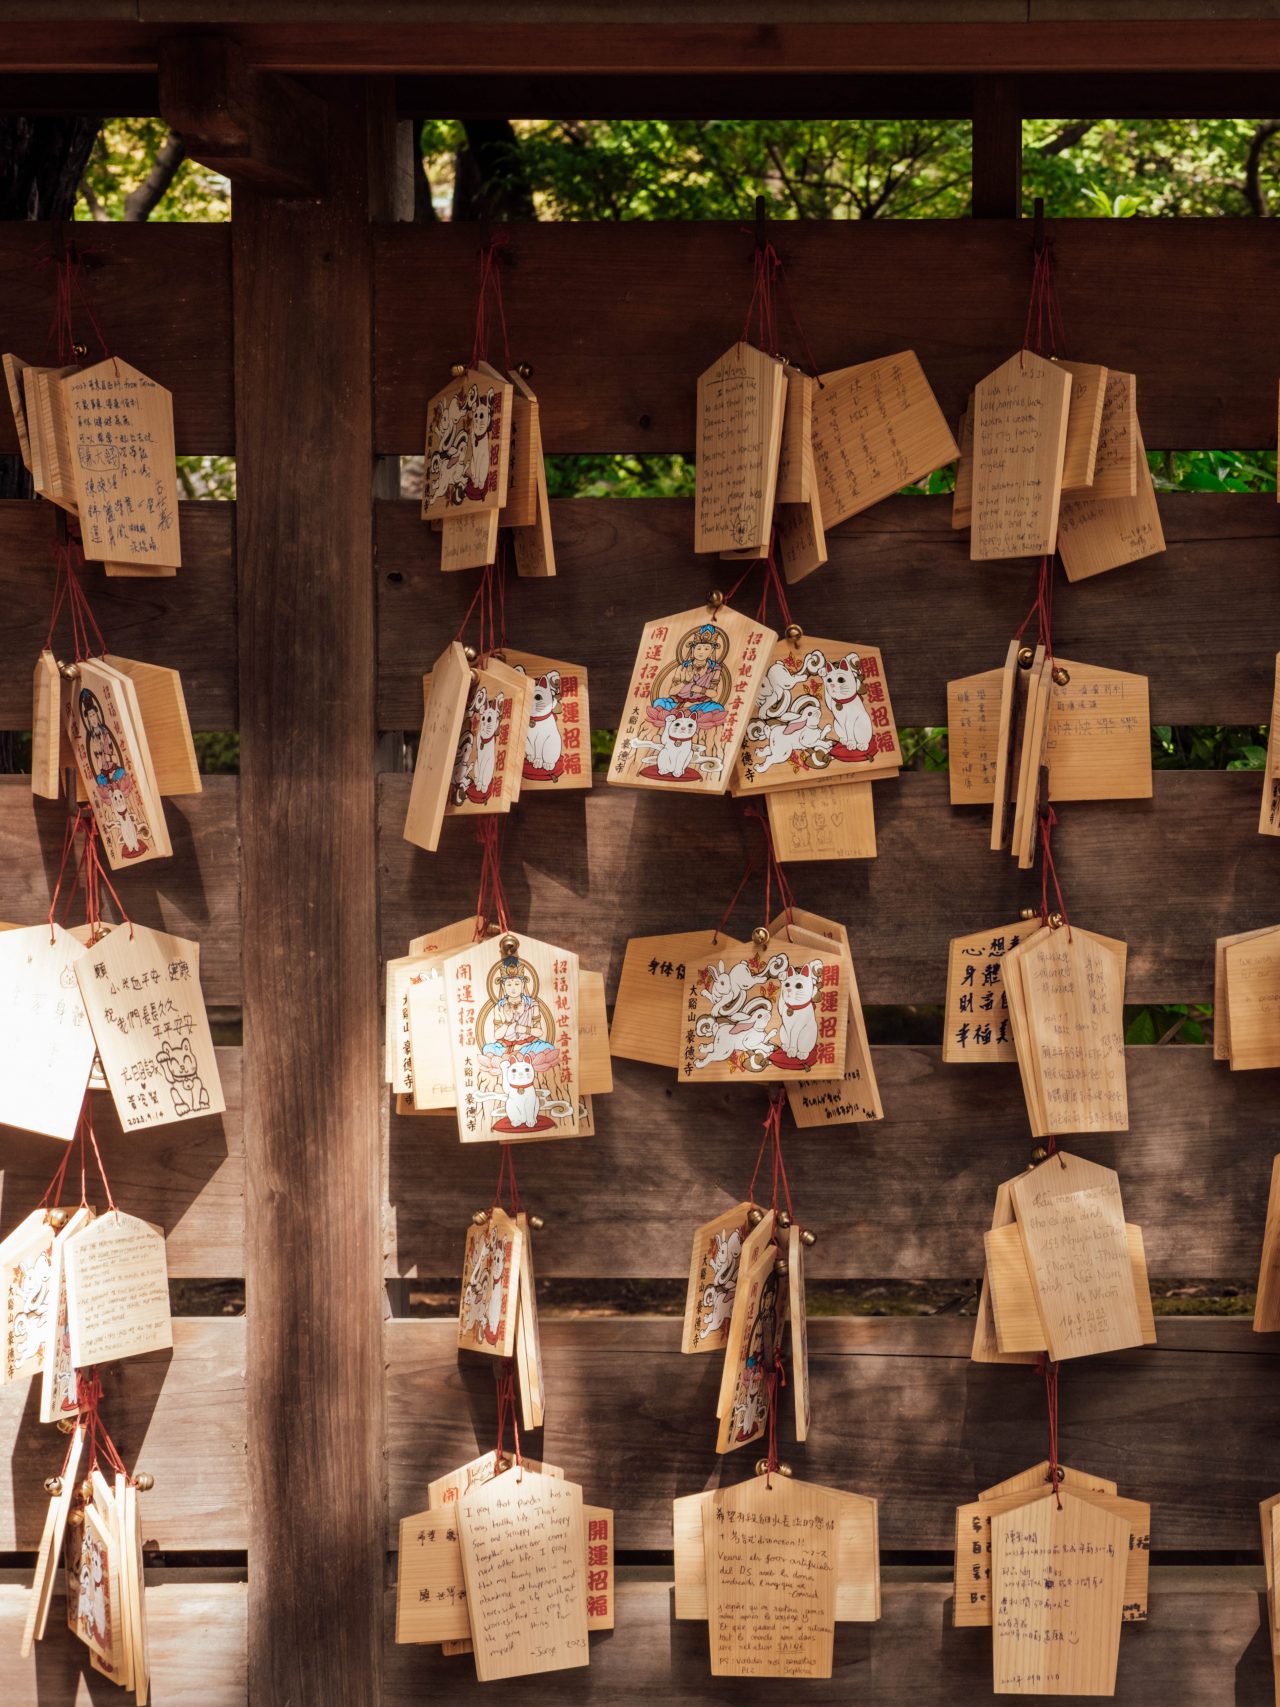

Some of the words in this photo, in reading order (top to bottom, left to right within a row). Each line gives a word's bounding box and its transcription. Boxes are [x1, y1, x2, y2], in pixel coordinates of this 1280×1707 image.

[633, 626, 669, 699] 開運招福
[720, 631, 764, 743] 招福観世音菩薩
[860, 656, 896, 753] 開運招福
[491, 697, 513, 798] 開運招福
[560, 676, 581, 775] 開運招福
[455, 964, 475, 1047] 開運招福
[553, 959, 574, 1085] 招福観世音菩薩
[687, 984, 697, 1022] 大谿山
[818, 964, 840, 1065] 開運招福
[464, 1056, 474, 1088] 大谿山
[683, 1027, 696, 1077] 豪徳寺
[587, 1519, 608, 1617] 開運招福
